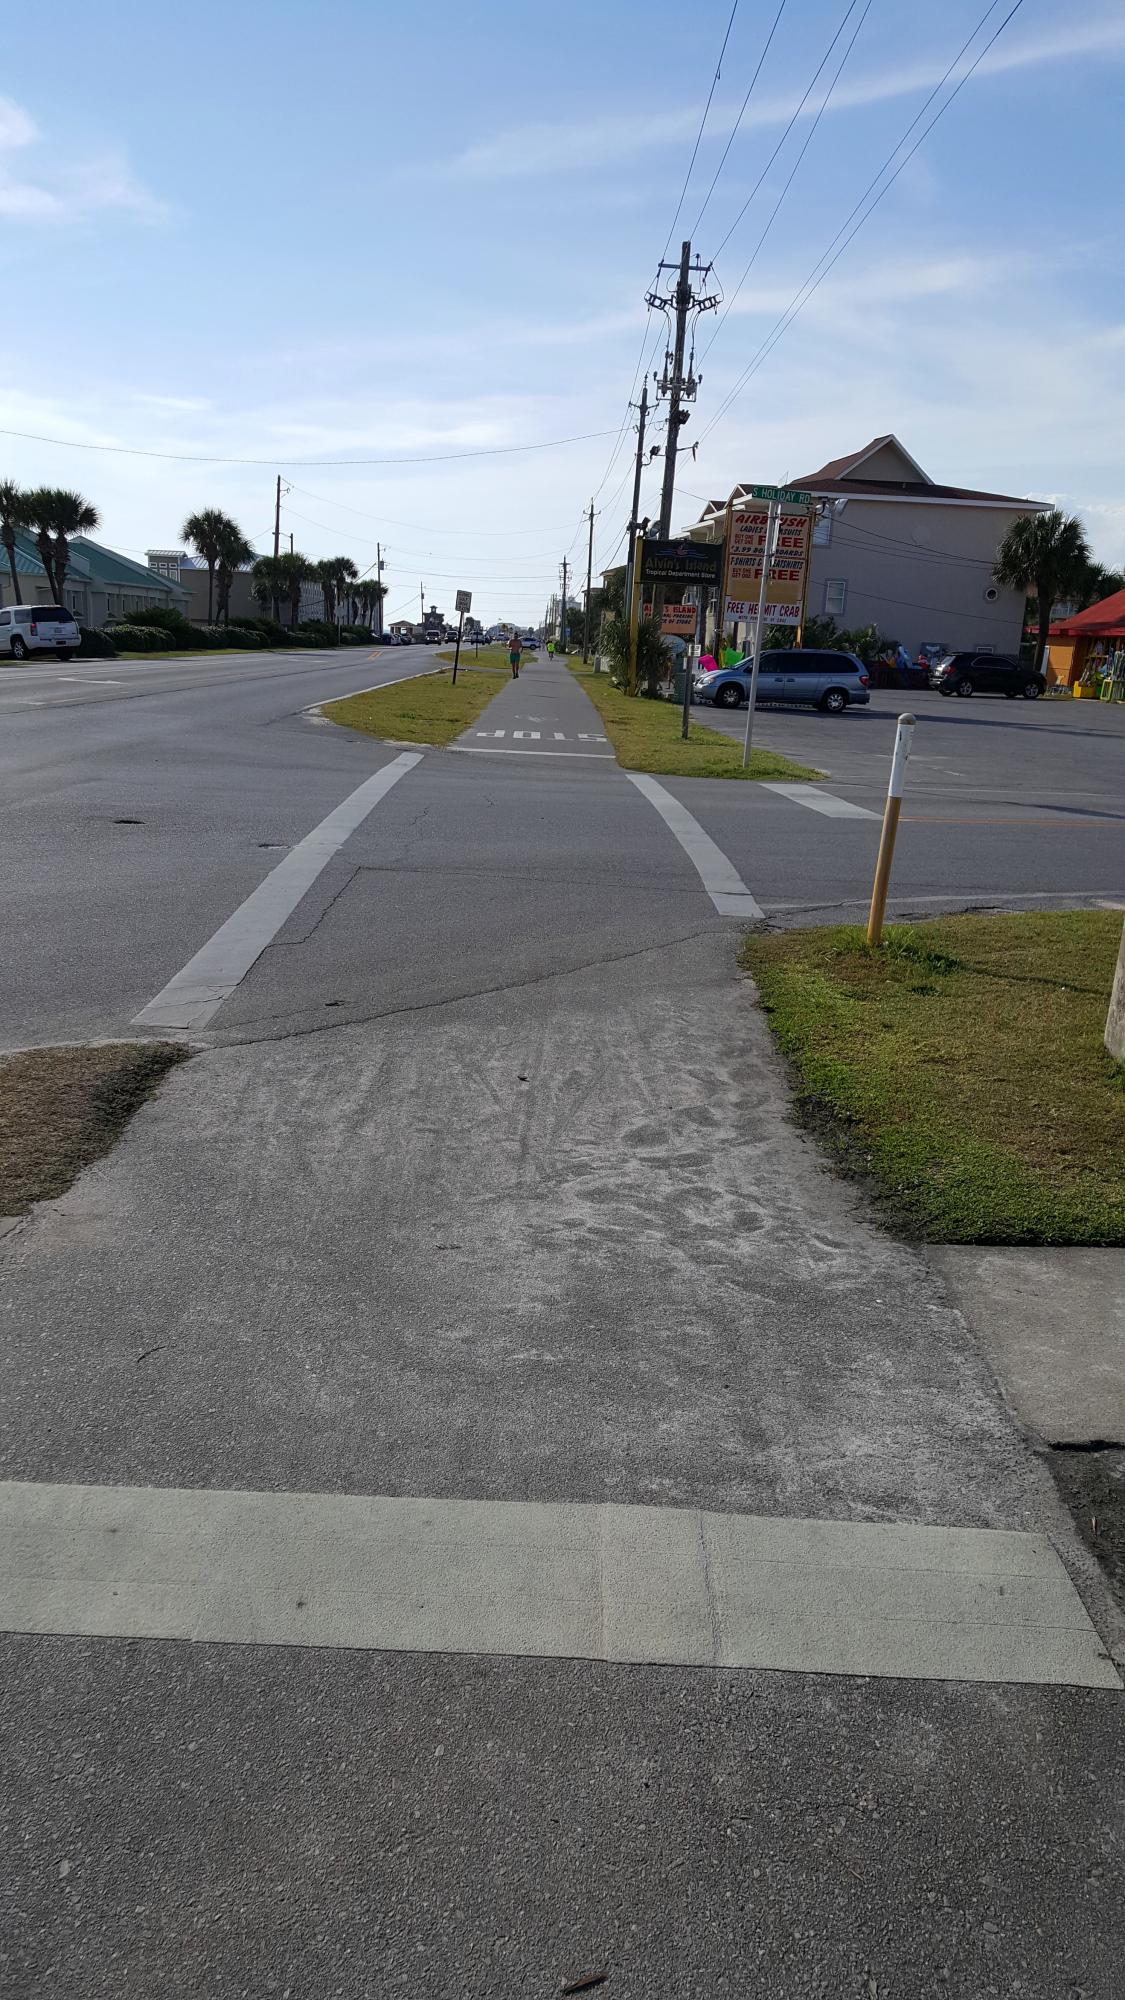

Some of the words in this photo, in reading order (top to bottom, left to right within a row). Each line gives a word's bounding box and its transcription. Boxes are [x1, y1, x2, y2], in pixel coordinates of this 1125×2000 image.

[753, 487, 759, 497] S
[761, 489, 796, 503] HOLIDAY
[799, 493, 811, 504] RD
[736, 514, 808, 528] AIRBUSH
[740, 525, 763, 535] LADIES
[758, 535, 804, 549] FEE
[686, 559, 717, 573] Island
[730, 556, 757, 567] T-SHIRTS
[768, 558, 805, 570] EATSHIRTS
[646, 568, 667, 576] Tropical
[667, 569, 701, 578] Department
[701, 571, 717, 579] Store
[727, 602, 745, 614] FREE
[747, 603, 778, 617] HEMIT
[779, 605, 801, 618] CRAB
